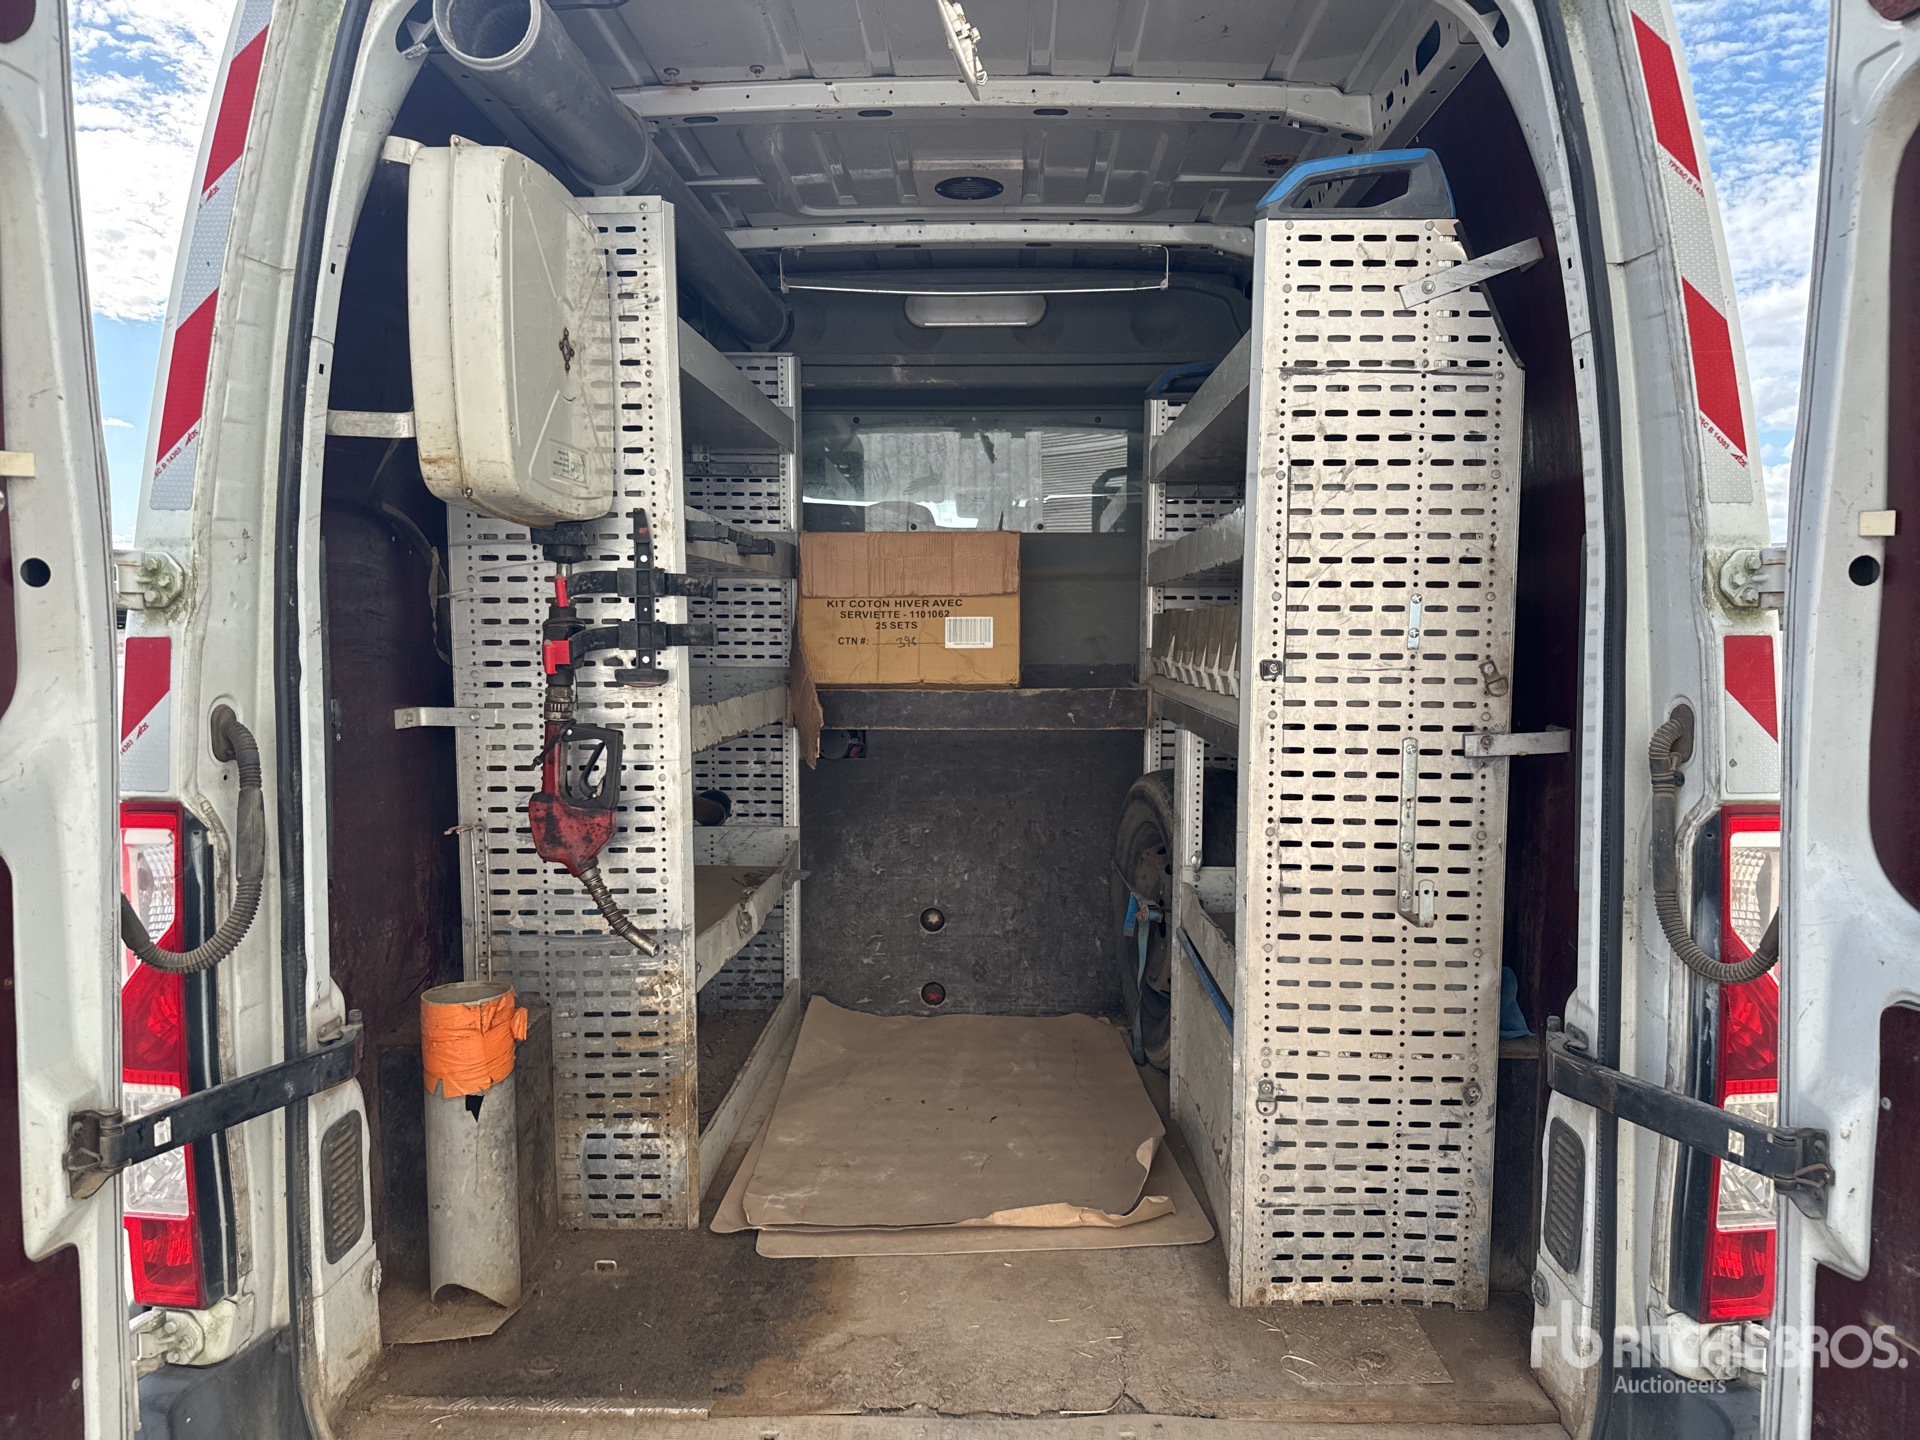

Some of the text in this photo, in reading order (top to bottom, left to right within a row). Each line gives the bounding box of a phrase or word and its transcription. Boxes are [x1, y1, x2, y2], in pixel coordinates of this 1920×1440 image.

[1707, 426, 1714, 434] B
[1713, 432, 1730, 450] 14303
[166, 446, 182, 463] 14303
[827, 599, 963, 608] KIT COTON HIVER AVEC
[840, 611, 900, 619] SERVIETTE
[910, 610, 950, 619] 1101062
[875, 621, 918, 630] 25 SETS
[838, 637, 858, 646] CTN
